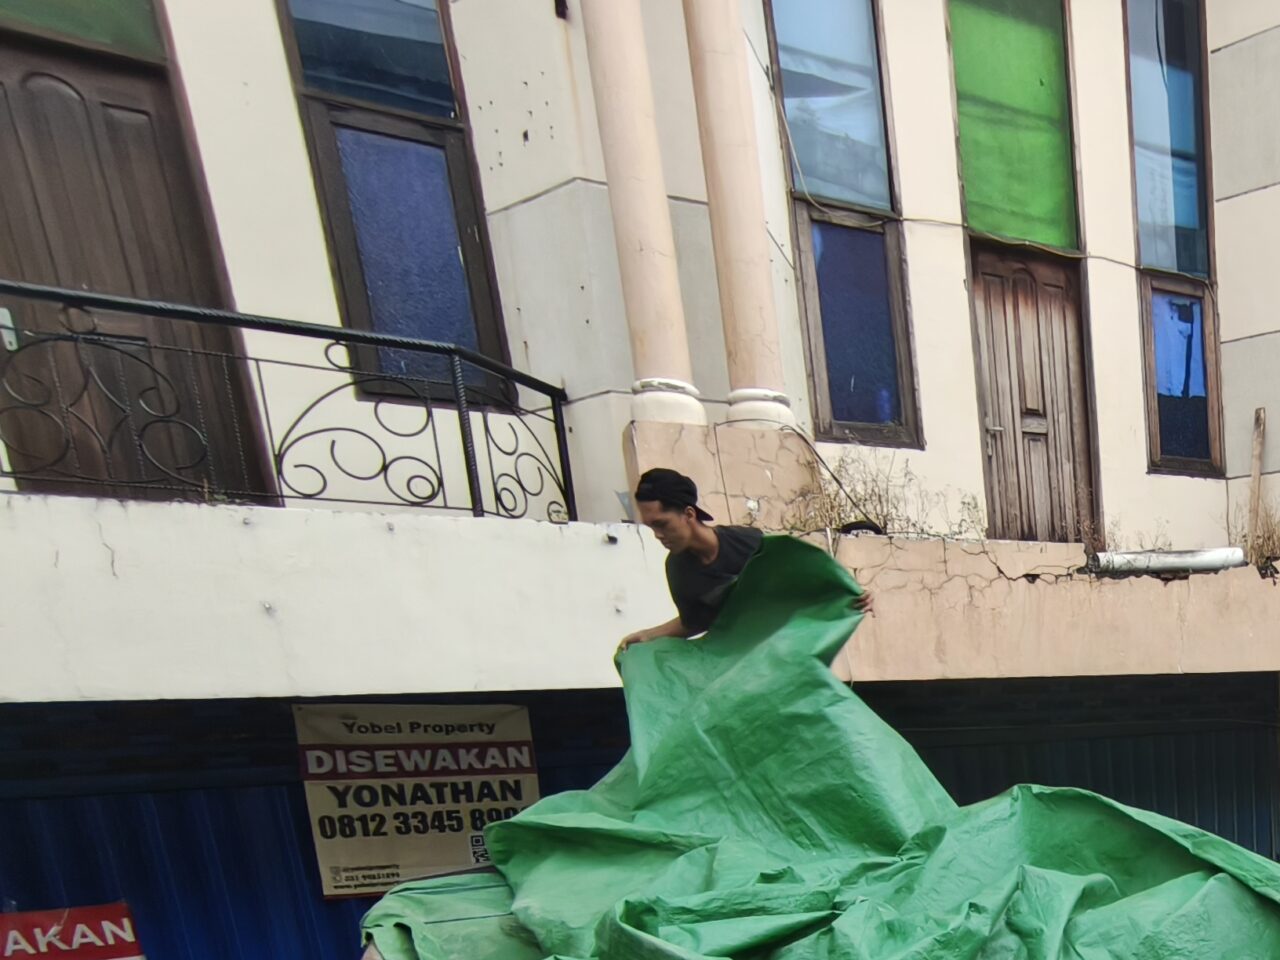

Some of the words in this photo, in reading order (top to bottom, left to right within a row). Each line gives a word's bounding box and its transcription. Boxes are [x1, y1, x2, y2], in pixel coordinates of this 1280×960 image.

[341, 721, 402, 735] Yobel
[408, 720, 496, 736] Property
[305, 746, 532, 774] DISEWAKAN
[327, 779, 523, 809] YONATHAN
[318, 813, 388, 839] 0812
[394, 809, 464, 836] 3345
[4, 917, 136, 957] AKAN
